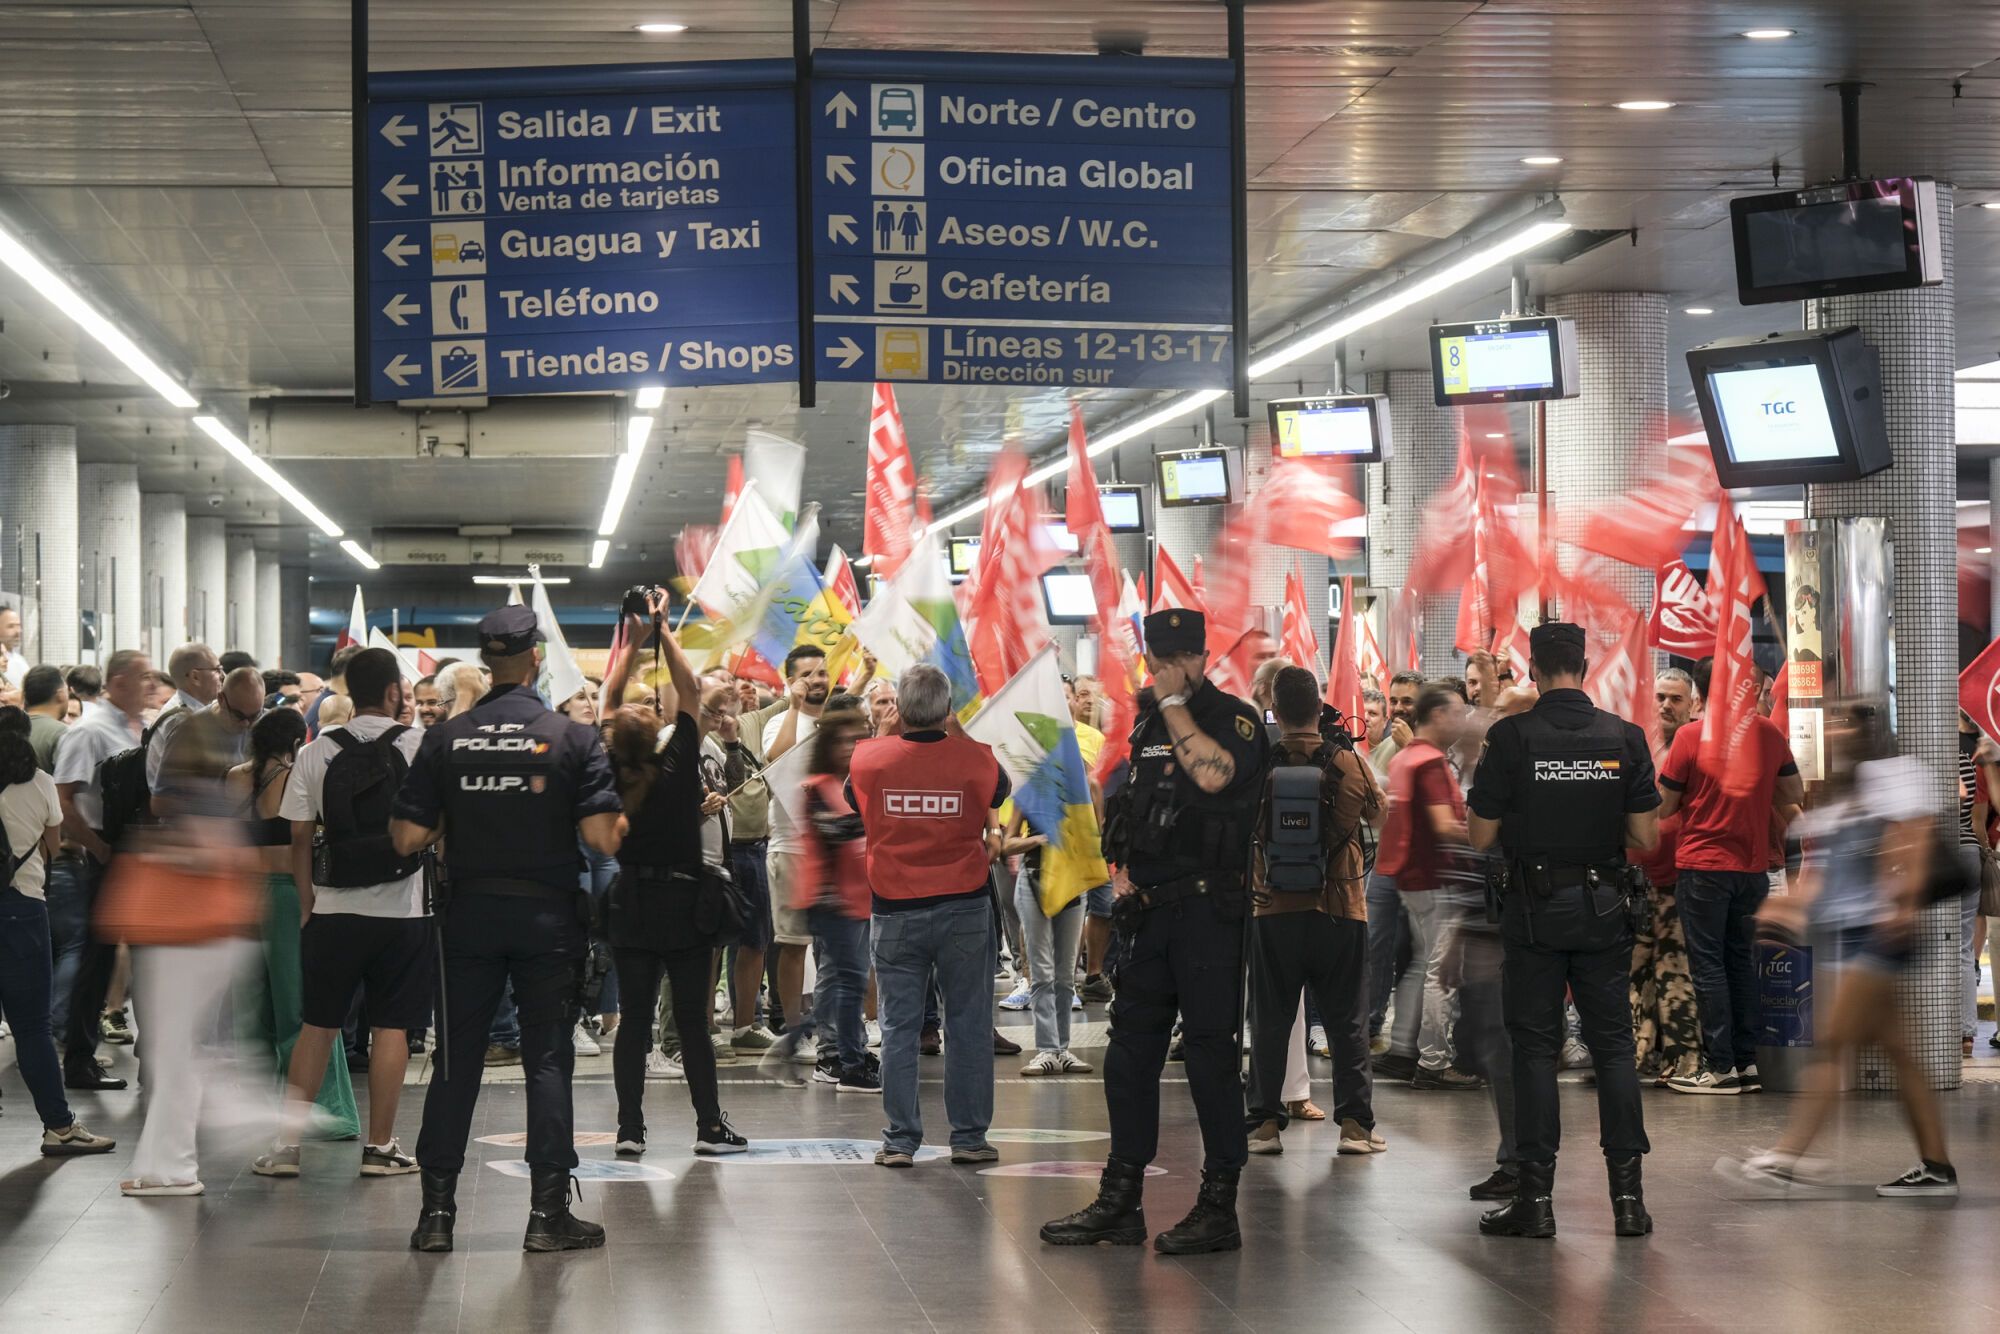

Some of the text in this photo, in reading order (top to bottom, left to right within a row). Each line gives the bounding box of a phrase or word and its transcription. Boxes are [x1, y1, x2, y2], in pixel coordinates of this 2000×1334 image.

[497, 109, 611, 140] Salida
[651, 106, 721, 134] Exit
[940, 96, 1040, 126] Norte
[1072, 99, 1196, 129] Centro
[499, 152, 720, 188] Información
[939, 156, 1193, 190] Oficina Global
[498, 183, 720, 212] Venta de tarjetas
[500, 220, 760, 262] Guagua y Taxi
[938, 216, 1050, 246] Aseos
[1079, 220, 1158, 248] W.C.
[942, 271, 1110, 303] Cafetería
[500, 287, 659, 318] Teléfono
[944, 329, 1229, 362] Líneas 12-13-17
[1449, 345, 1460, 367] 8
[500, 346, 649, 379] Tiendas
[679, 341, 794, 373] Shops
[943, 360, 1114, 383] Dirección sur
[1761, 401, 1796, 415] TGC
[1284, 417, 1293, 435] 7
[453, 738, 536, 753] POLICIA
[1535, 760, 1603, 770] POLICIA
[1535, 771, 1620, 780] NACIONAL
[461, 776, 528, 791] U.I.P.
[886, 795, 959, 813] CCOO
[1282, 815, 1309, 826] LiveU
[1769, 961, 1792, 973] TGC
